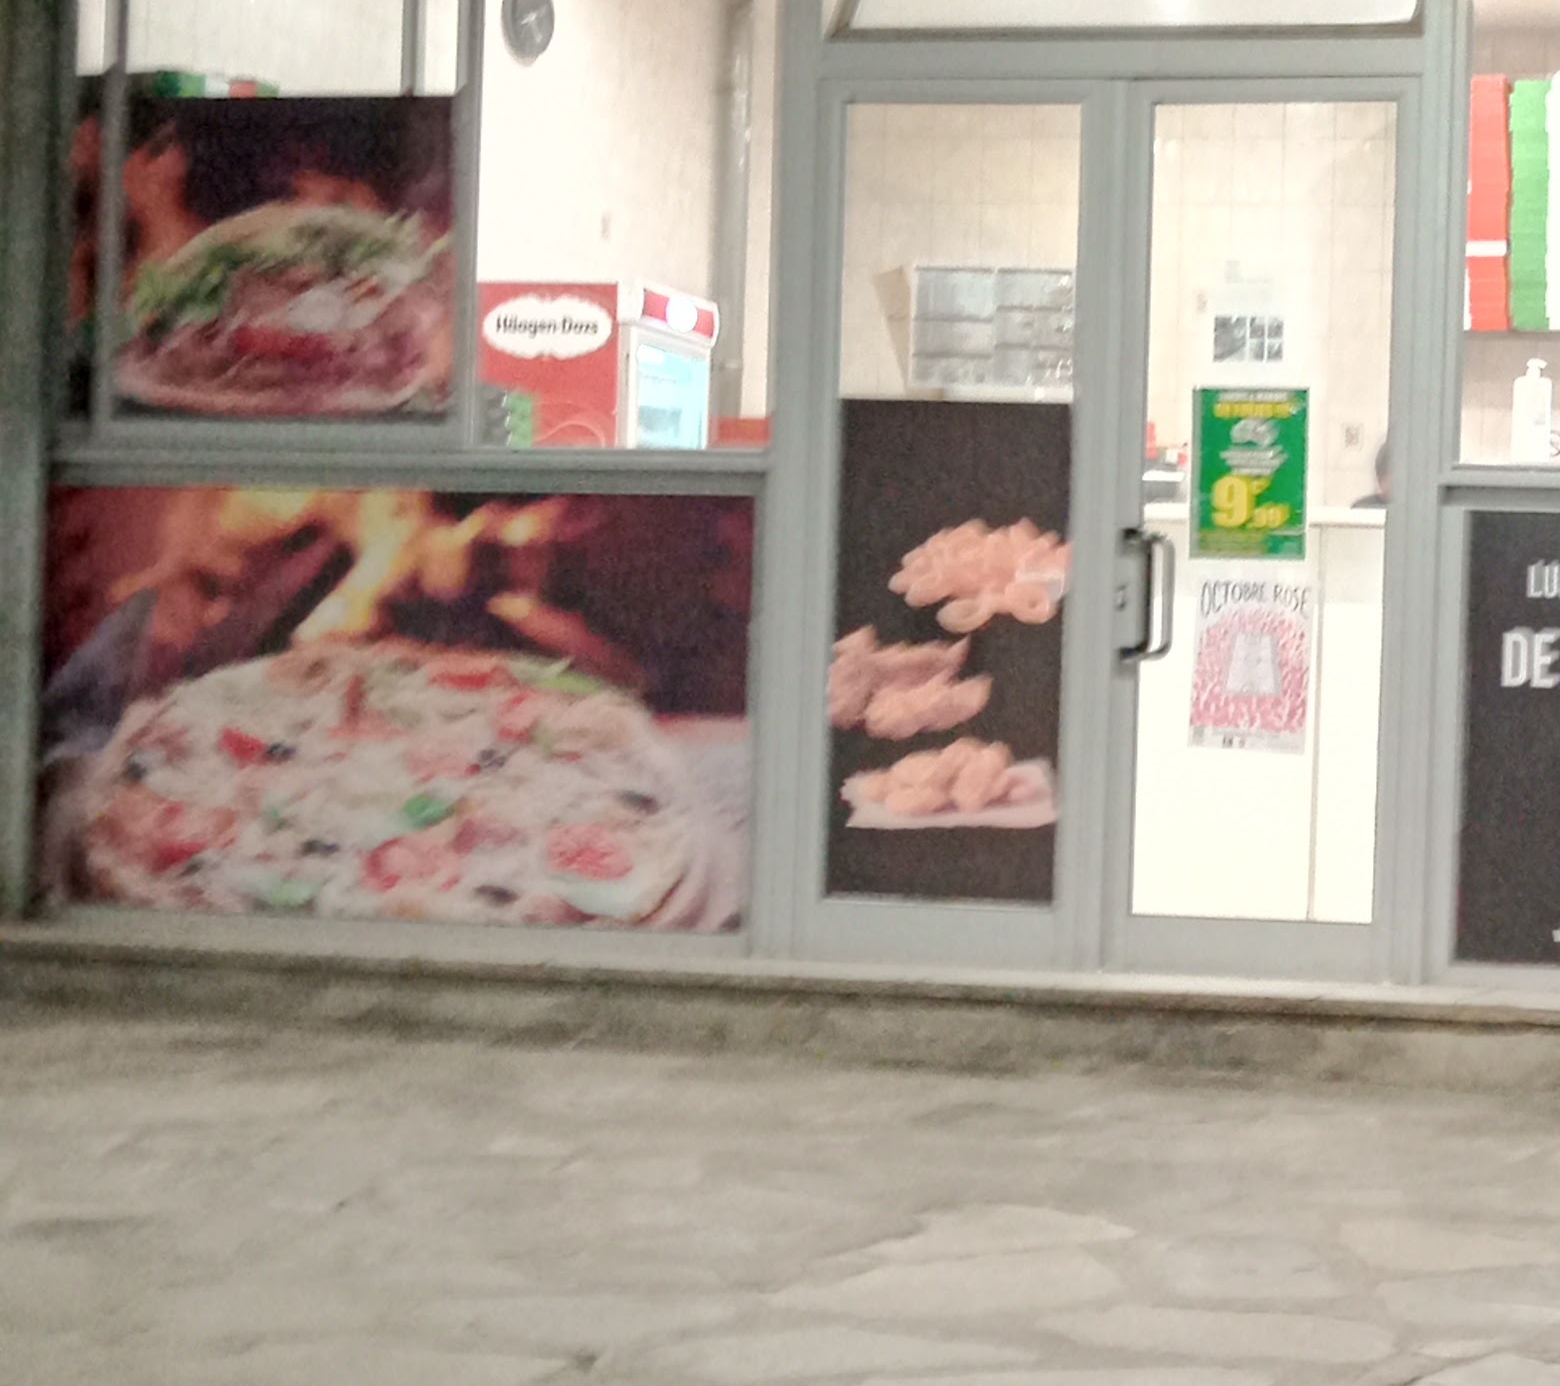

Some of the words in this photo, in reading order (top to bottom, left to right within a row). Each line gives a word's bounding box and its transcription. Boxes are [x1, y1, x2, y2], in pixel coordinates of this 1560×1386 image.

[1211, 475, 1251, 529] 9
[1200, 580, 1267, 617] OCTOBRE
[1273, 584, 1311, 619] ROSE
